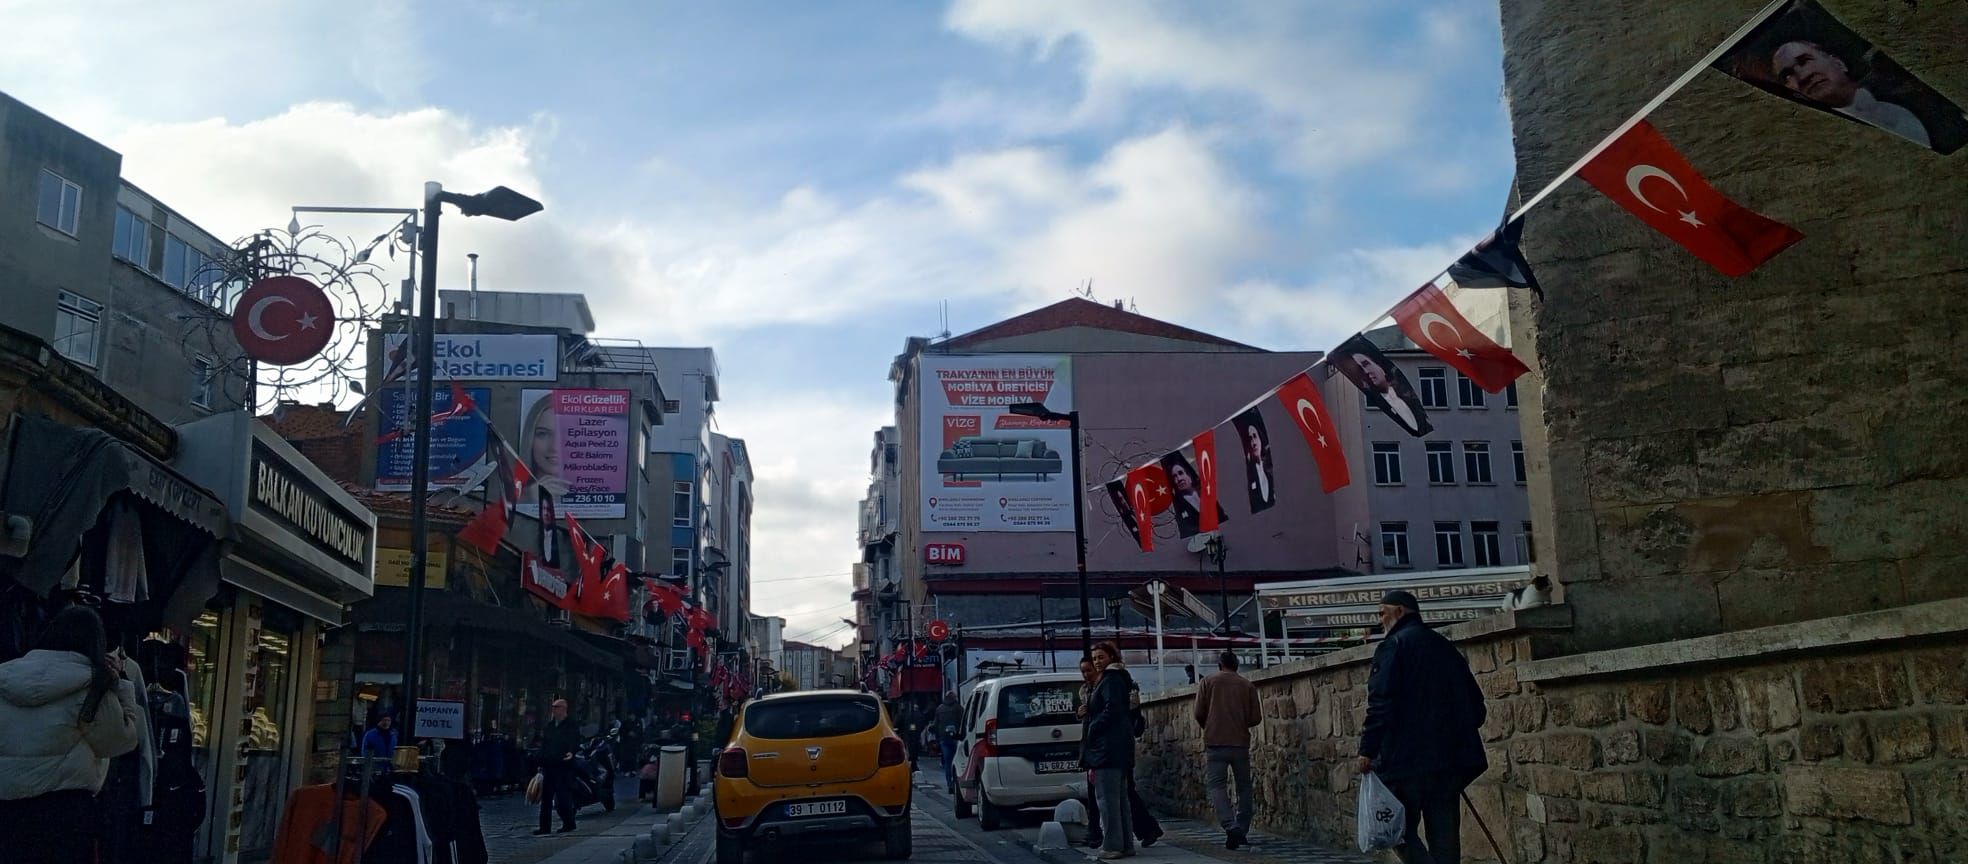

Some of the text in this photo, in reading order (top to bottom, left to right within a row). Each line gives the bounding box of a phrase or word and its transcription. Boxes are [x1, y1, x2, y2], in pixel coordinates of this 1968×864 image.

[434, 340, 482, 358] Ekol
[434, 359, 545, 377] Hastanesi
[936, 368, 1055, 379] TRAKYA'NIN EN BÜYÜK
[948, 381, 1048, 392] MOBİLYA ÜRETİCİSİ
[435, 391, 449, 400] Bir
[562, 394, 626, 404] Ekol Güzellik
[961, 394, 1033, 405] VİZE MOBİLYA
[563, 405, 623, 413] KIRKLARELİ
[579, 418, 607, 426] Lazer
[568, 428, 617, 438] Epilasyon
[565, 440, 586, 448] Aqua
[563, 463, 617, 472] Mikroblading
[569, 485, 610, 493] Eyes/Face
[575, 494, 591, 502] 236
[592, 494, 603, 502] 10
[604, 494, 615, 502] 10
[257, 461, 365, 564] BALKAN KUYUMCULUK
[929, 545, 961, 560] BİM
[1289, 590, 1386, 606] KIRKLARE
[420, 719, 452, 728] 700 TL
[1040, 762, 1048, 770] 34
[790, 802, 844, 815] 39 T 0112
